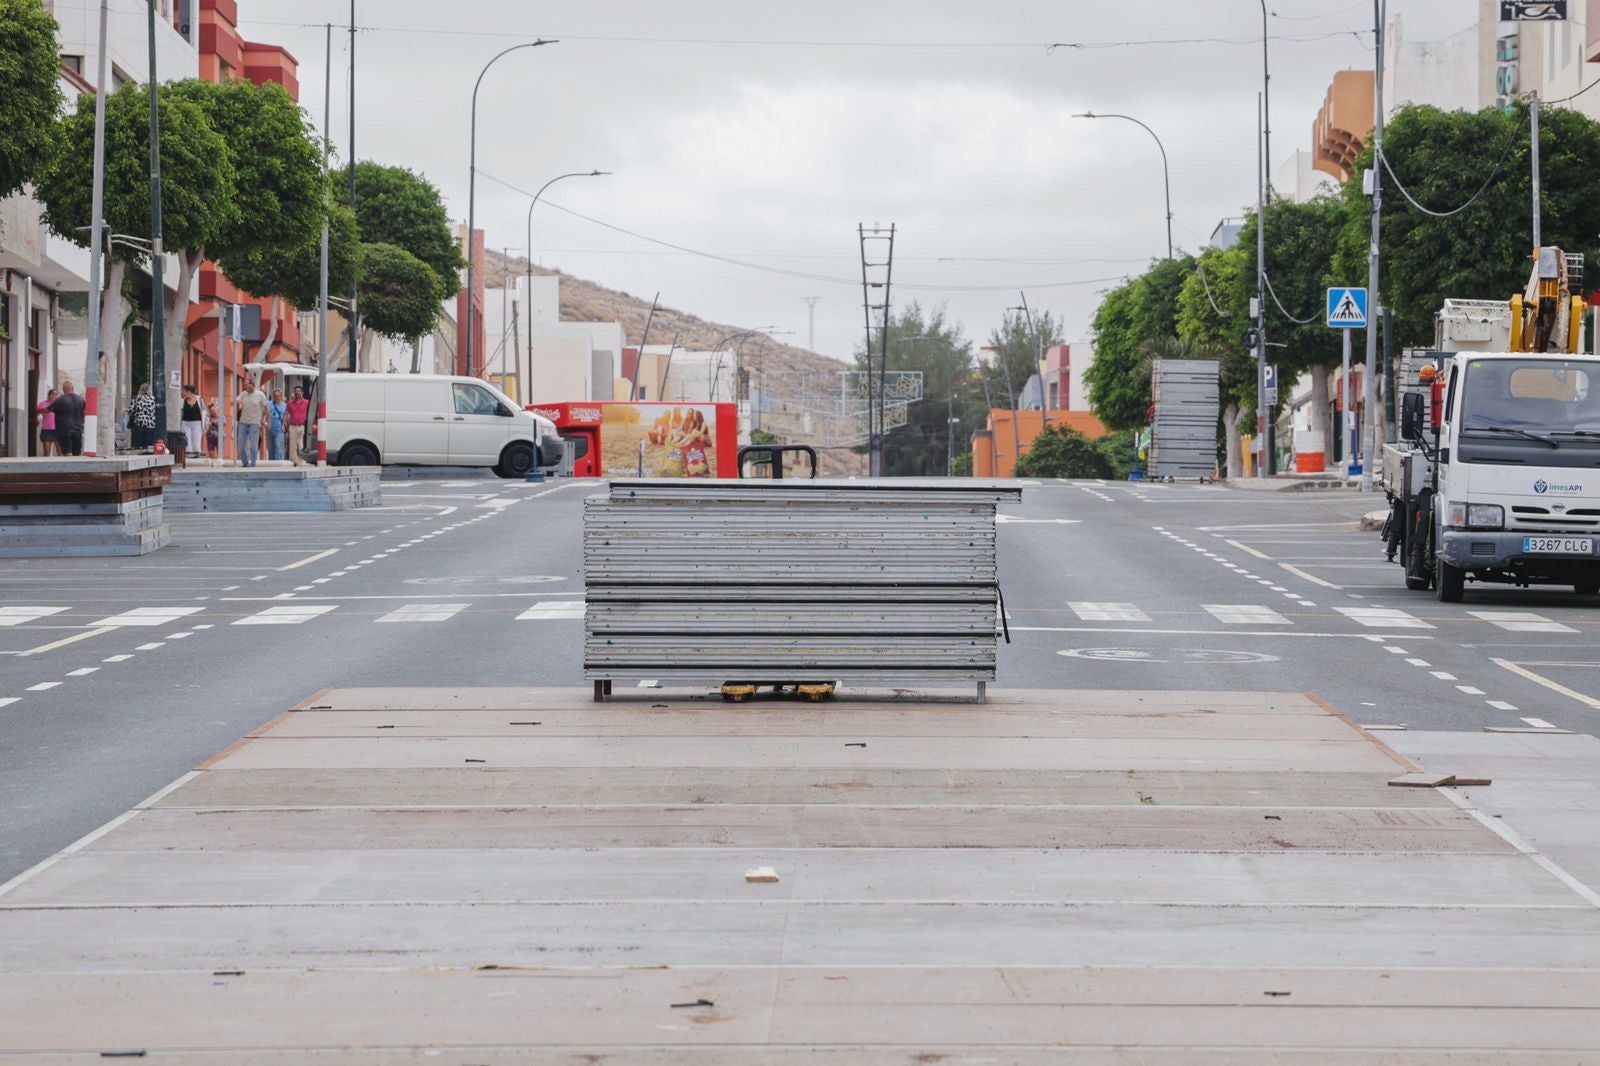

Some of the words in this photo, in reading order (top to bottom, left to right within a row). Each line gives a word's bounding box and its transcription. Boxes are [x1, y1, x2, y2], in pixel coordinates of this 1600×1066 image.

[1264, 365, 1273, 388] P
[1549, 483, 1582, 491] imesAPI
[1531, 539, 1561, 552] 3267
[1564, 540, 1588, 552] CLG
